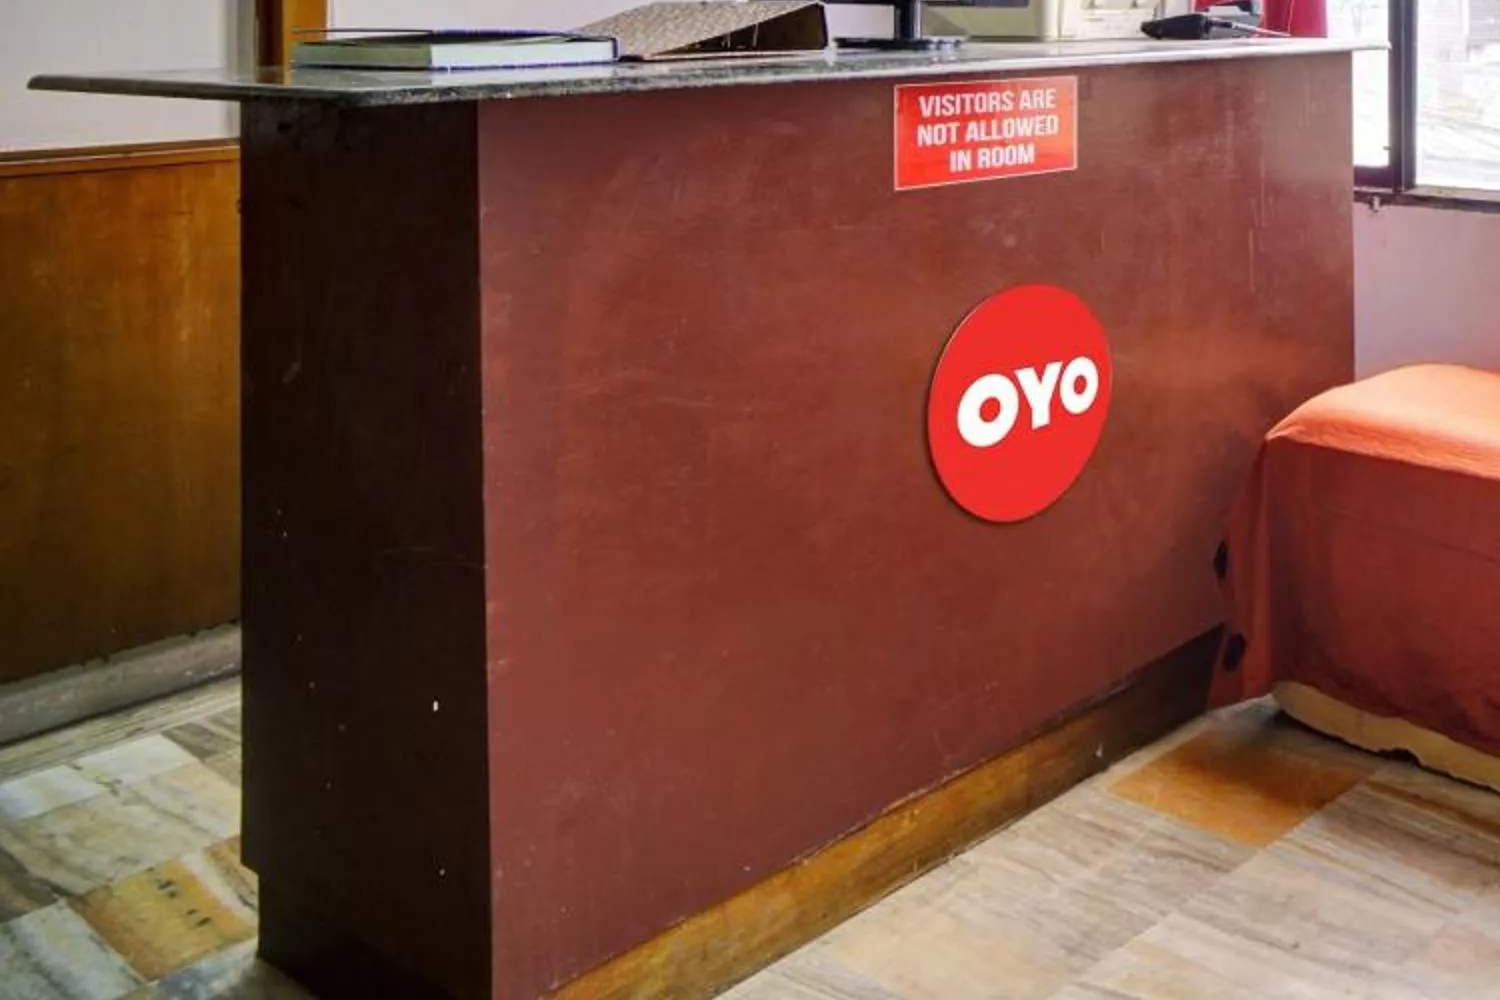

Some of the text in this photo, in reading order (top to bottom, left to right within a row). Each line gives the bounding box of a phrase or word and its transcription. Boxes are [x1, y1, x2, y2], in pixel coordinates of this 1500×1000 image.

[919, 88, 1057, 118] VISITORS ARE
[917, 115, 1059, 147] NOT ALLOWED
[950, 143, 1036, 173] IN ROOM
[956, 355, 1099, 449] OYO
